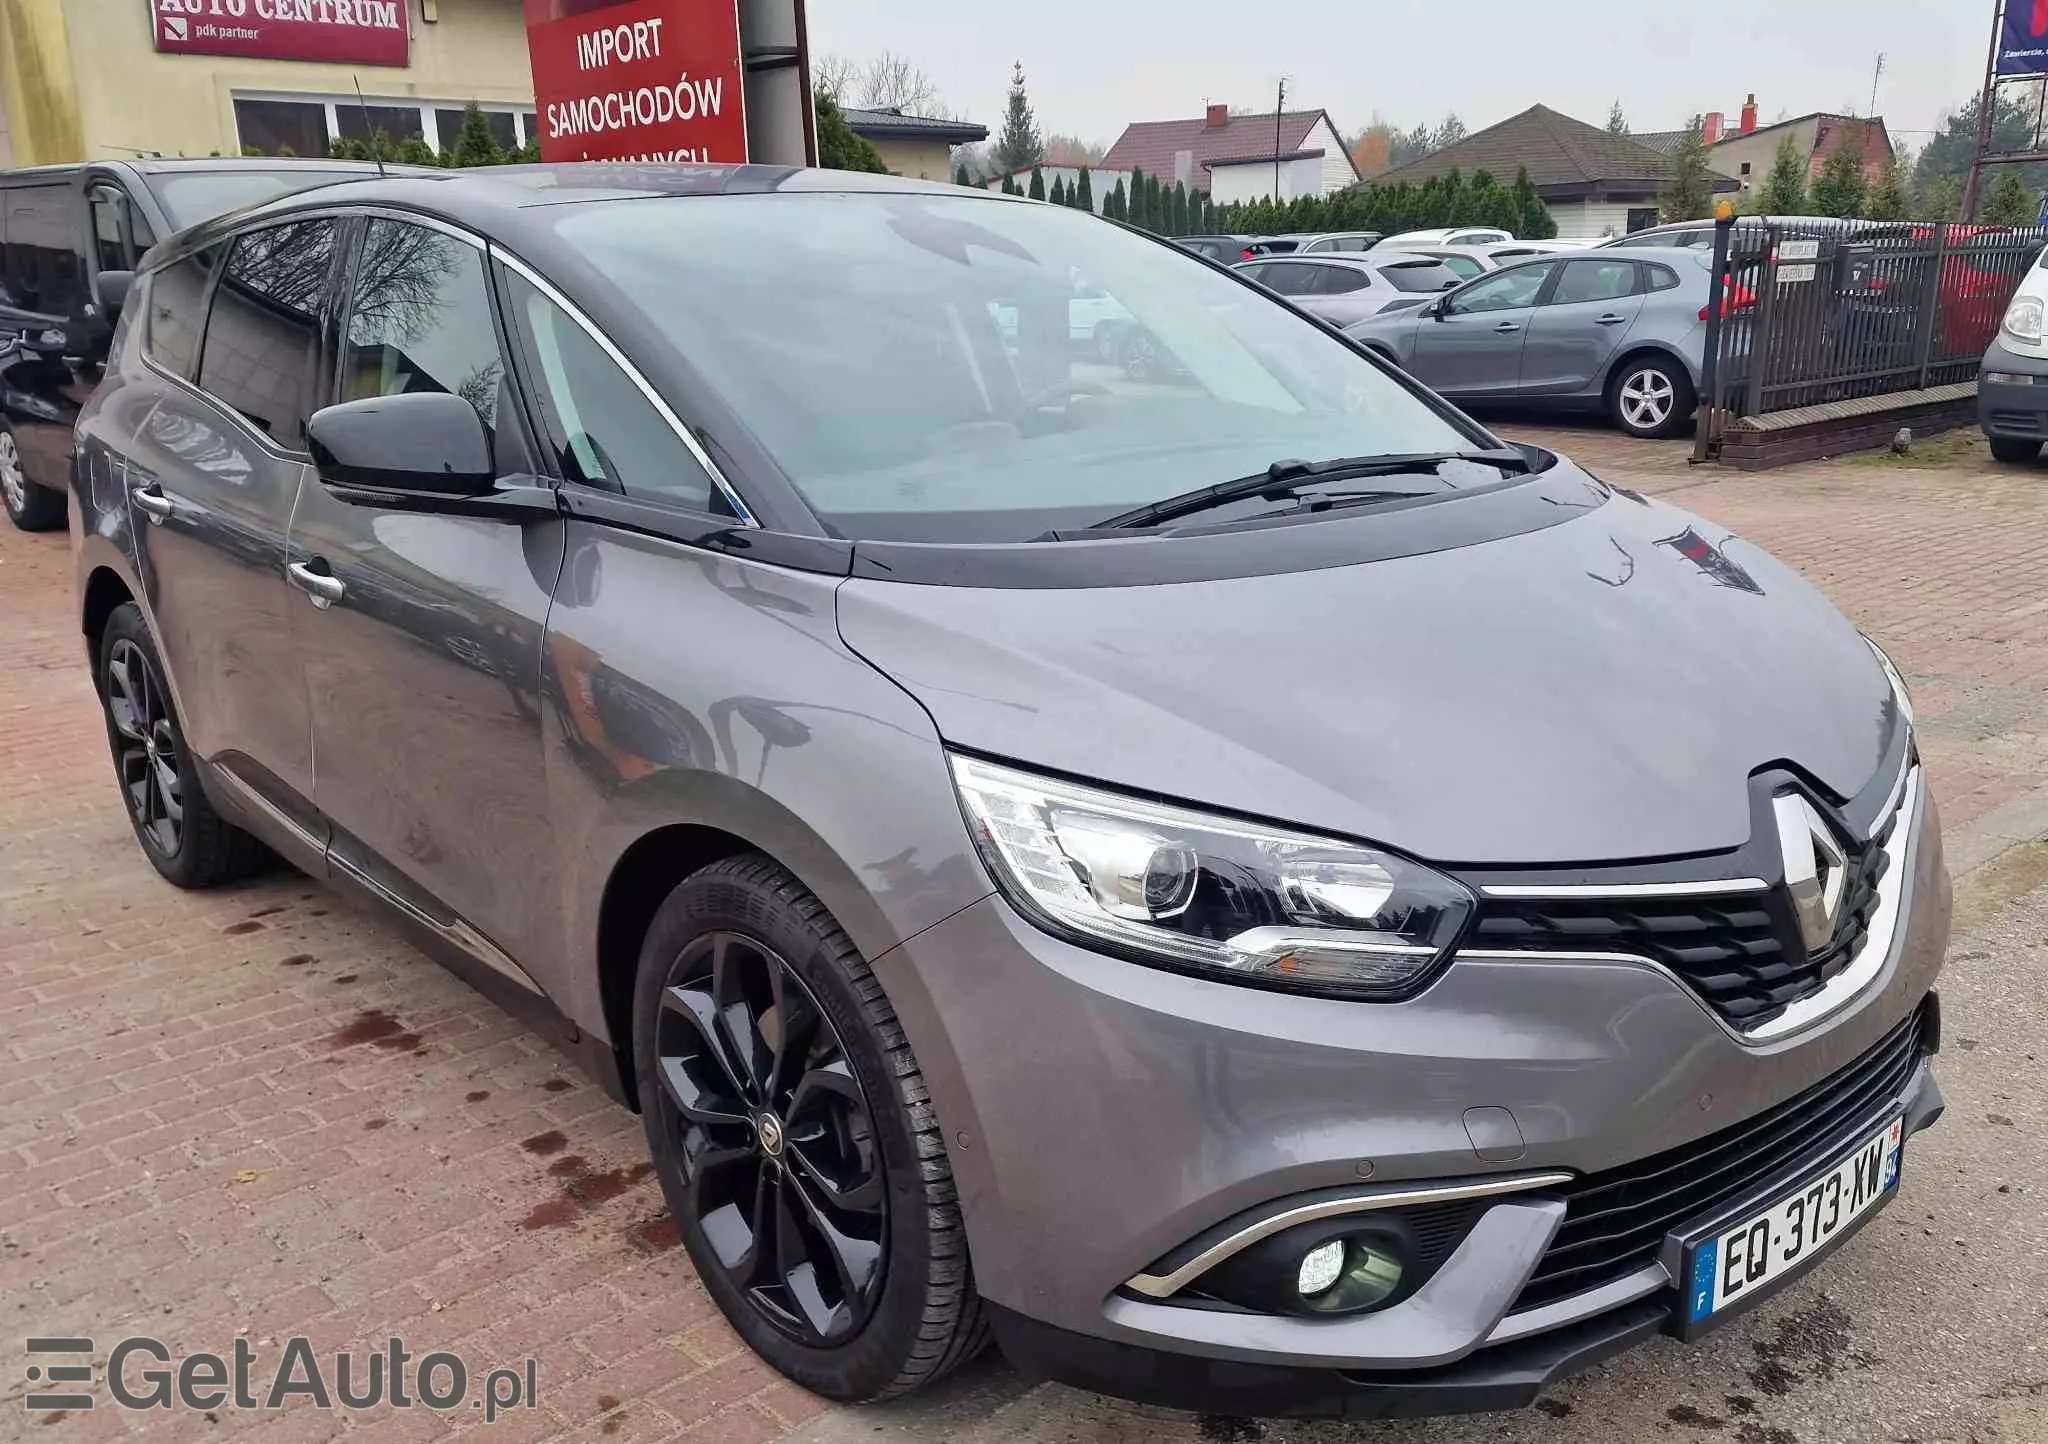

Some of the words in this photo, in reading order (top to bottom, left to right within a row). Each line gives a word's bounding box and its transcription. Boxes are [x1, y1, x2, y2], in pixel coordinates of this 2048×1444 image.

[195, 24, 218, 38] pdk
[219, 26, 259, 39] partner
[255, 0, 399, 28] CENTRUM
[576, 18, 662, 70] IMPORT
[547, 71, 723, 139] SAMOCHODÓW
[1722, 1137, 1885, 1298] EQ-373-XW
[1697, 1291, 1707, 1311] F
